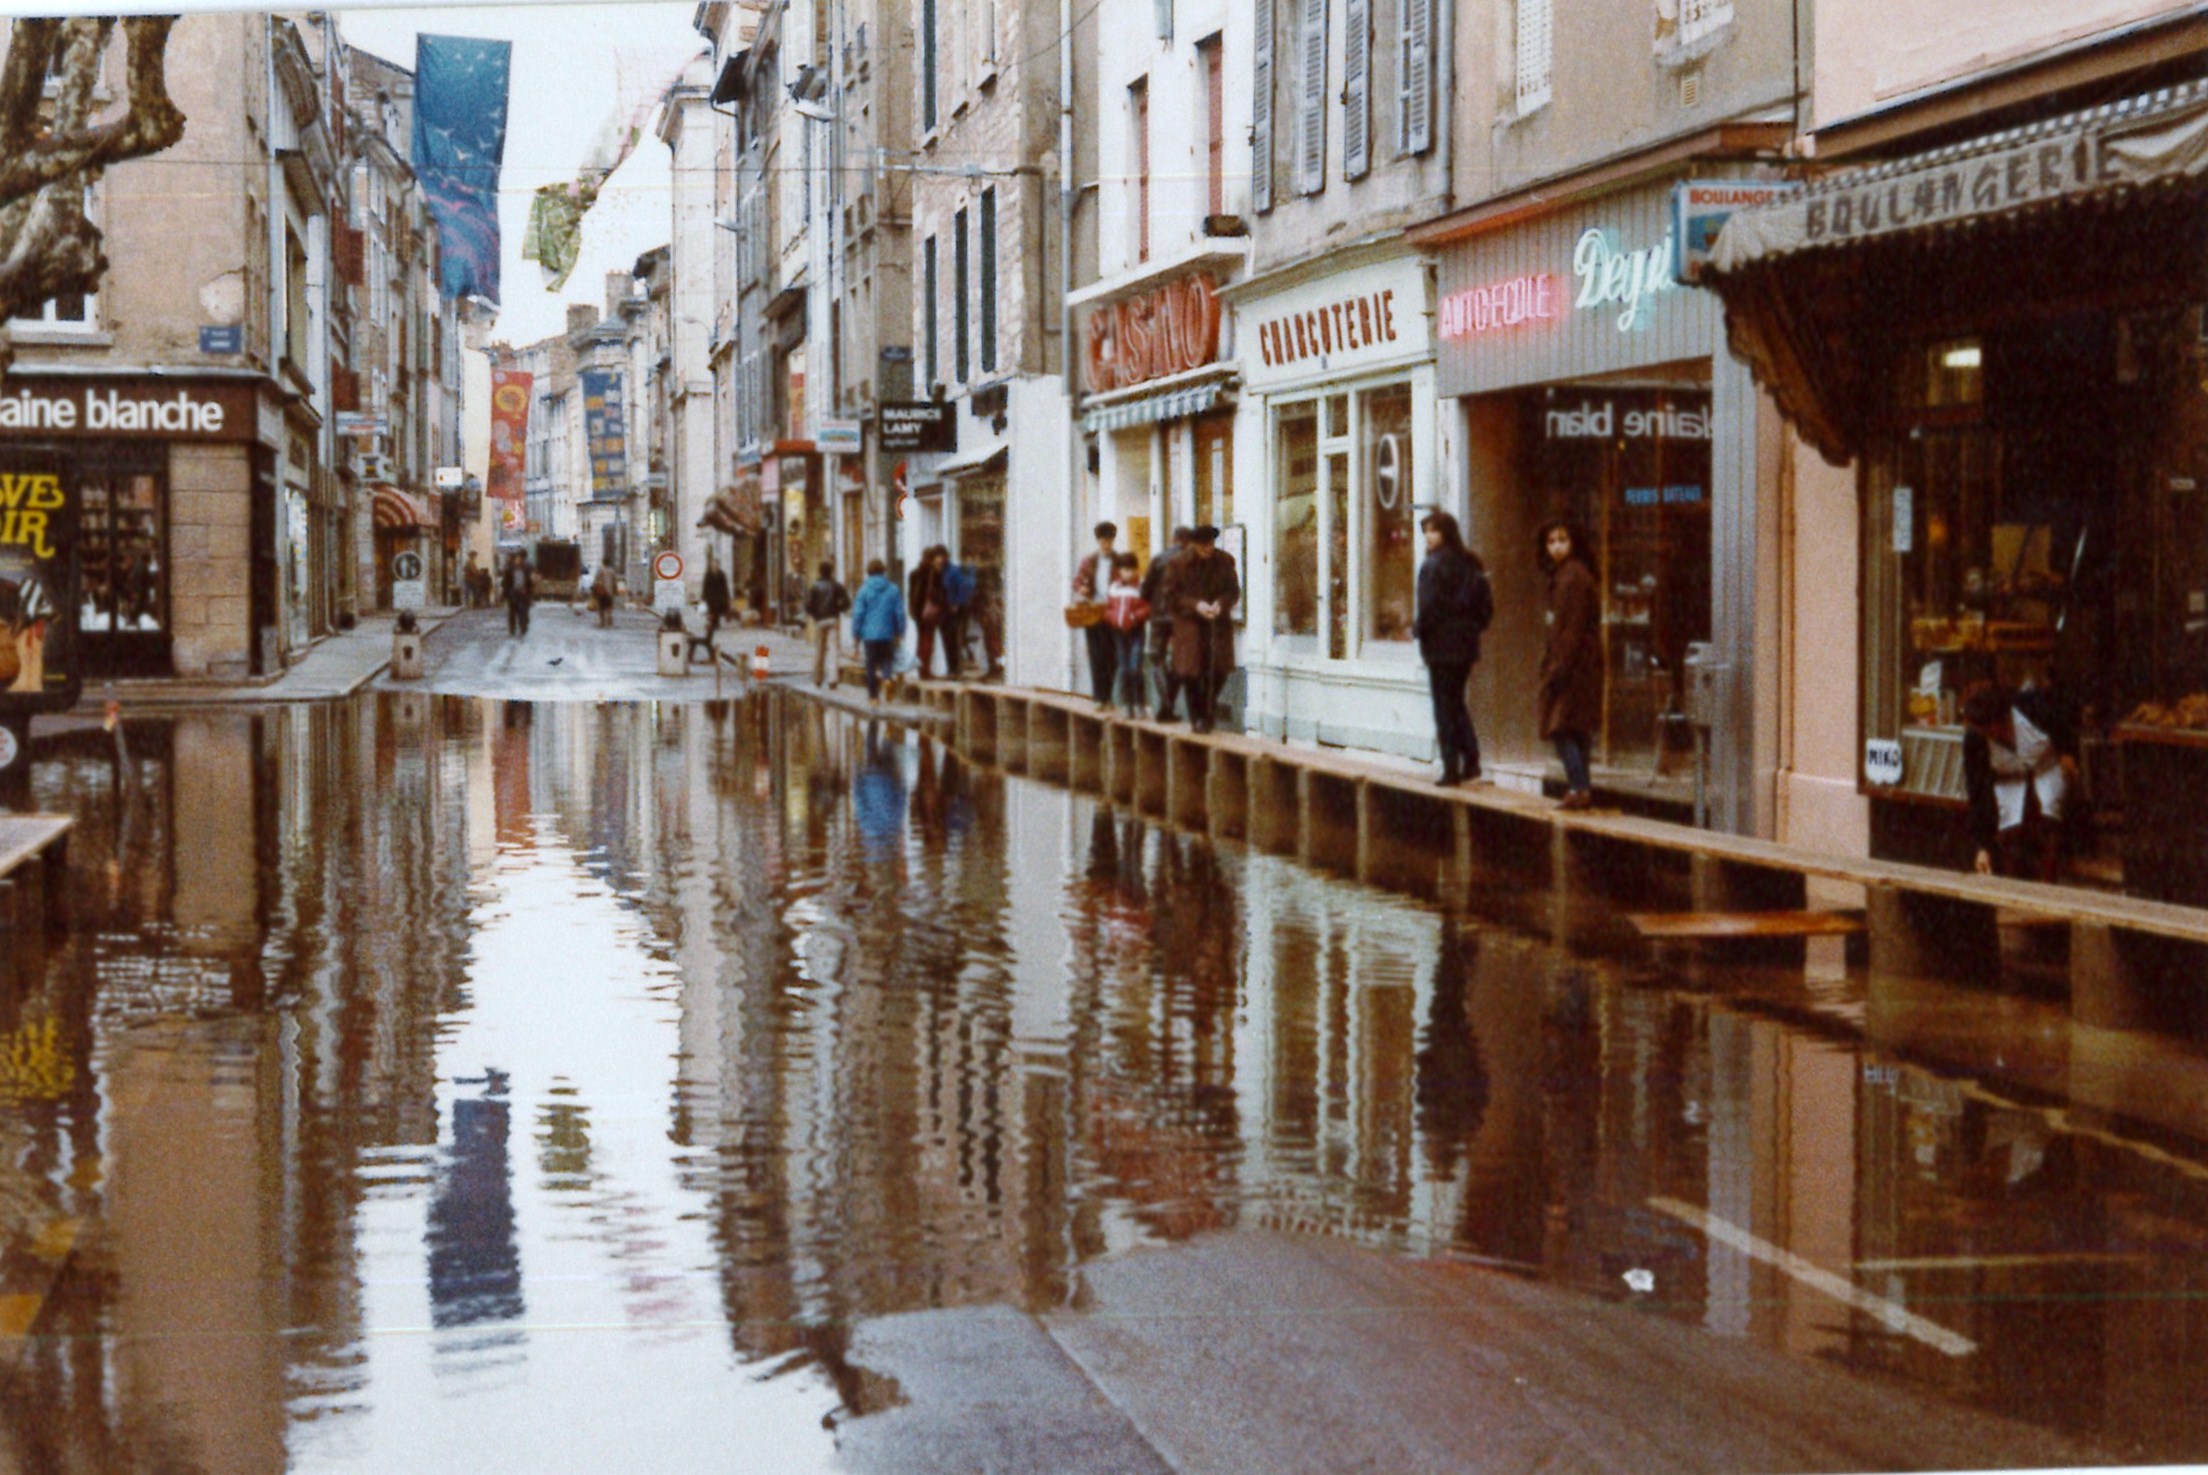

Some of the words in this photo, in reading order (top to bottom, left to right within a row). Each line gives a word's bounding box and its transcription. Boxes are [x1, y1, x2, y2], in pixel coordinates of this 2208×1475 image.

[1085, 271, 1220, 393] CASINO
[1259, 288, 1398, 367] CHARCUTERIE
[0, 388, 77, 429] aine
[85, 387, 225, 432] blanche
[882, 408, 942, 421] MAURICE
[883, 422, 921, 435] LAMY
[0, 510, 56, 559] IR
[1868, 749, 1902, 768] MIKO
